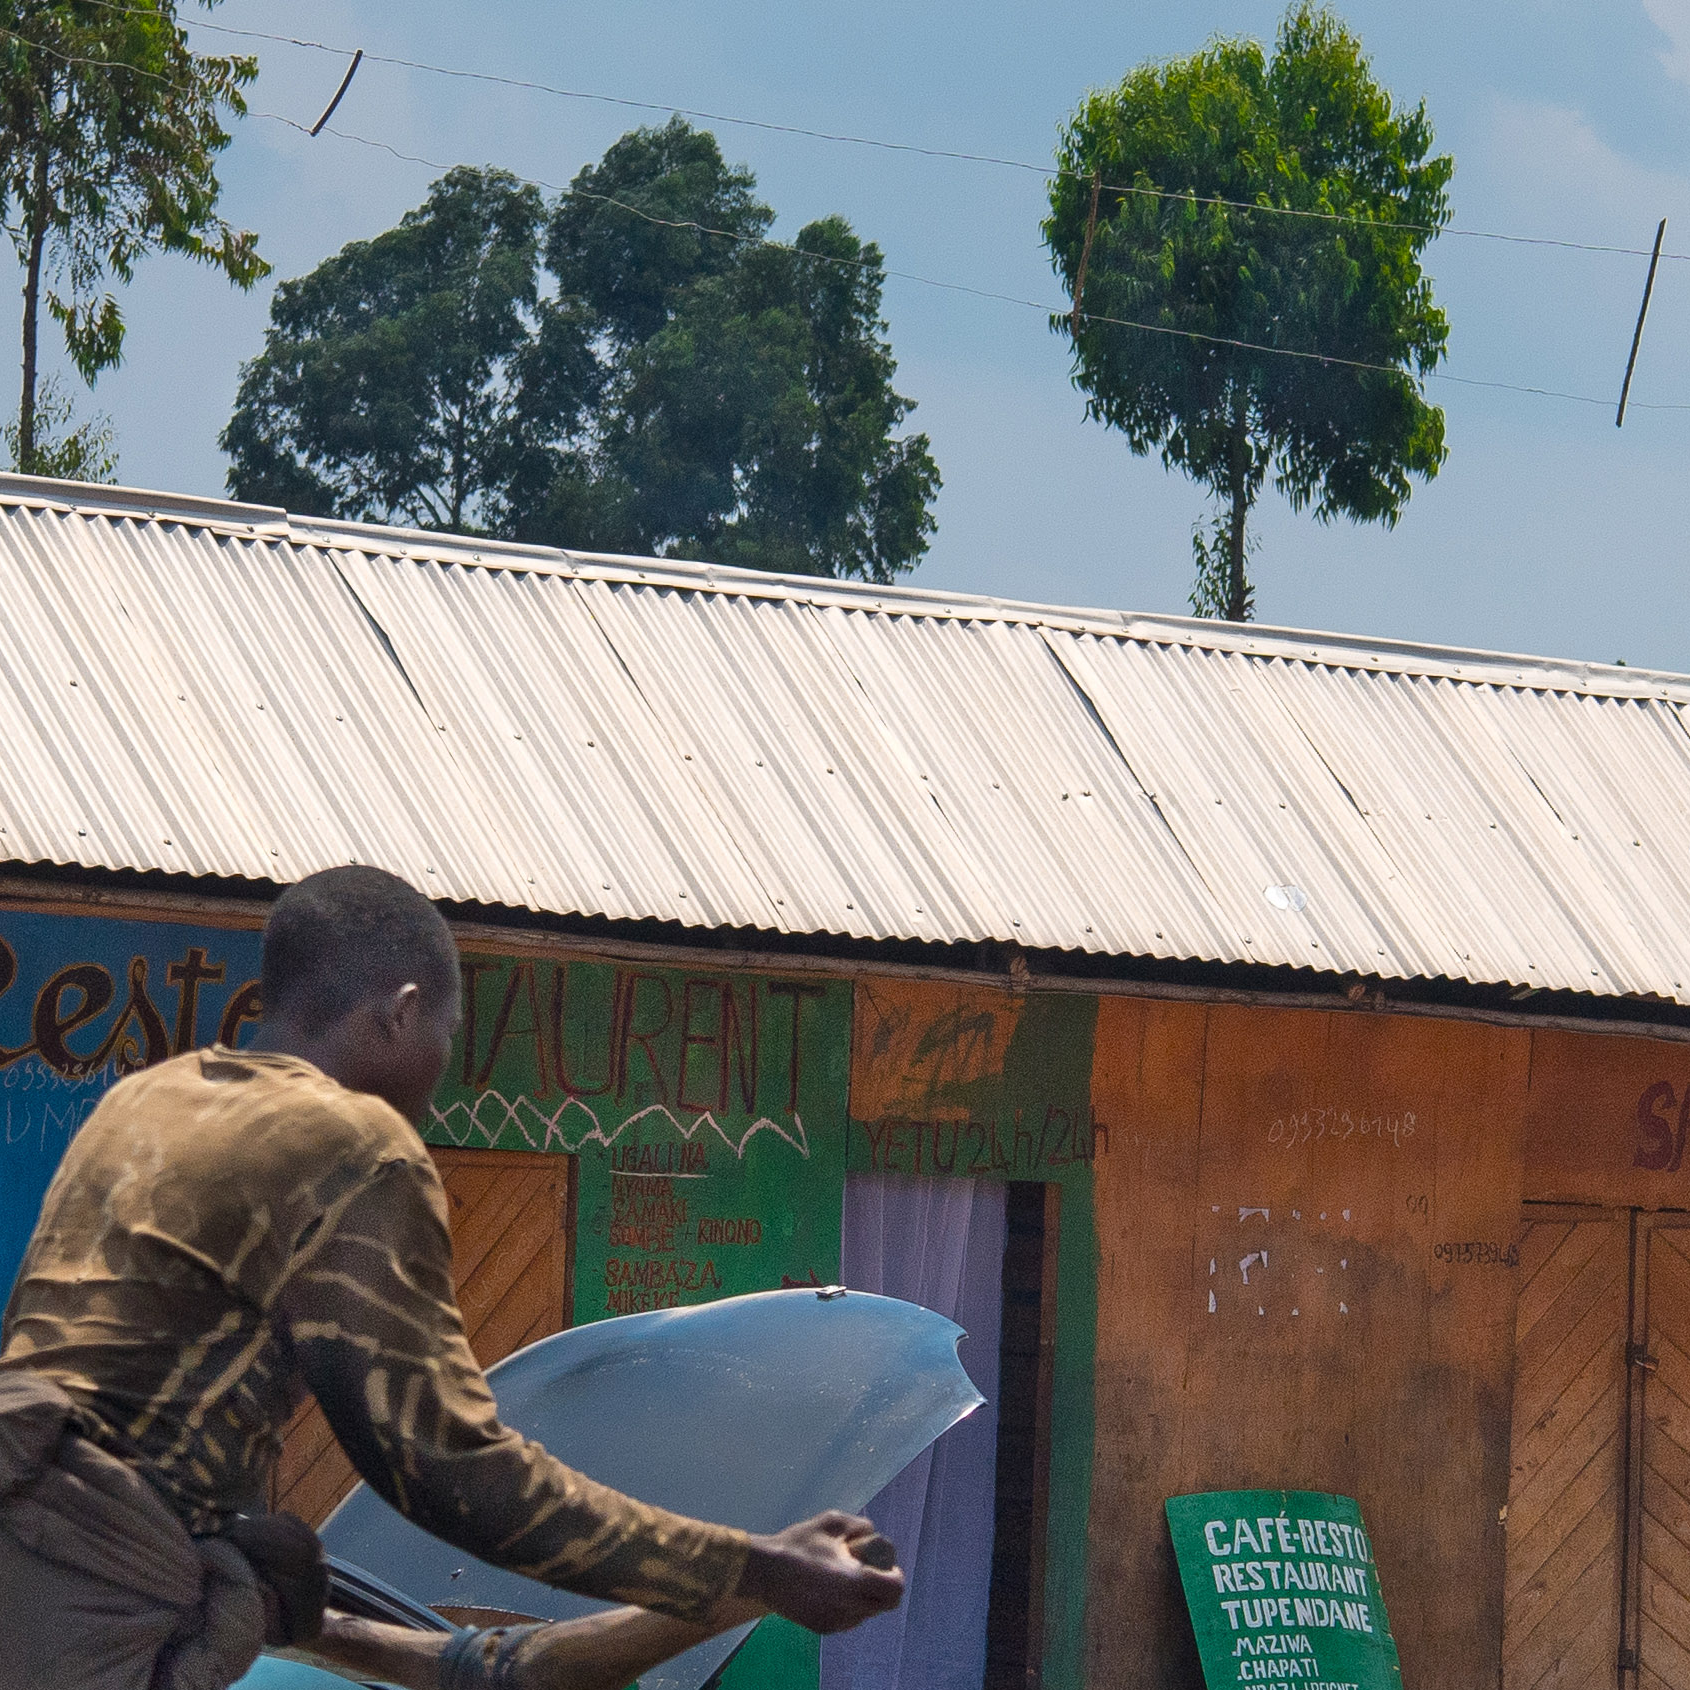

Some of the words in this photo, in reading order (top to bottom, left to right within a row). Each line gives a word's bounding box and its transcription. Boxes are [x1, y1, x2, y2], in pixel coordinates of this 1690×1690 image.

[461, 962, 826, 1114] TAURENT
[862, 1119, 959, 1174] YETU
[613, 1197, 688, 1226] SAMAKI
[1203, 1510, 1370, 1563] CAFÉ-RESTO
[1212, 1560, 1368, 1598] RESTAURANT
[1220, 1598, 1374, 1633] TUPENDANE
